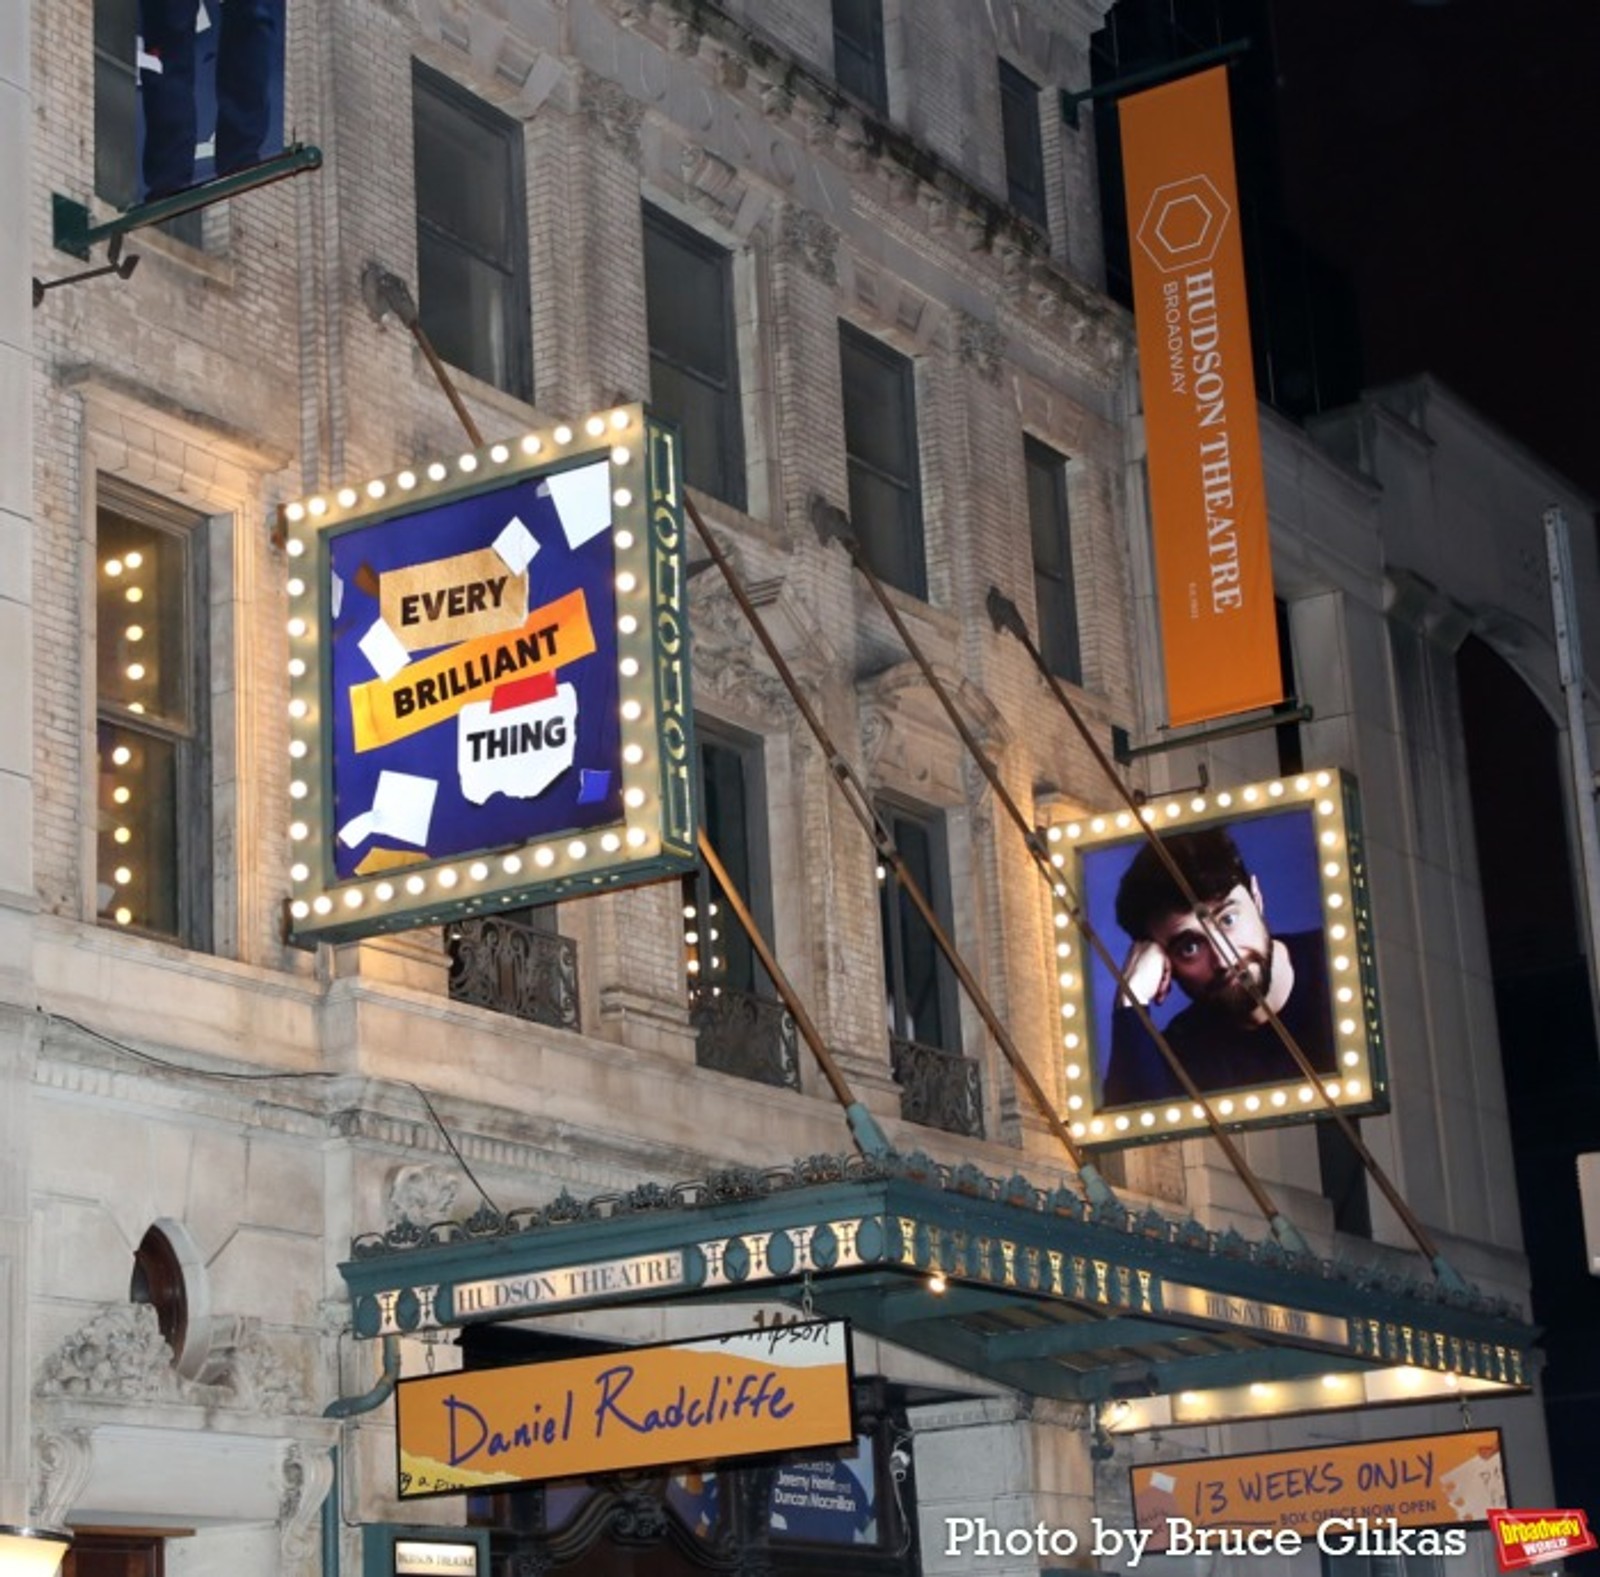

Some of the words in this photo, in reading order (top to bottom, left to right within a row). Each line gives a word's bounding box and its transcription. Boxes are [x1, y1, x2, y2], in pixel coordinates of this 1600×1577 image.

[1163, 281, 1186, 395] BROADWAY
[1185, 267, 1227, 427] HUDSON
[1200, 432, 1243, 614] THEATRE
[401, 575, 509, 626] EVERY
[393, 623, 559, 719] BRILLIANT
[466, 715, 567, 762] THING
[457, 1276, 558, 1313] HUDSON
[565, 1256, 682, 1296] THEATRE
[442, 1390, 573, 1467] Daniel
[594, 1365, 796, 1438] Radcliffe
[1195, 1480, 1229, 1517] 13
[1240, 1462, 1343, 1502] WEEKS
[1357, 1450, 1434, 1490] ONLY
[1280, 1512, 1307, 1526] BOX
[1312, 1505, 1357, 1522] OFFICE
[1361, 1503, 1395, 1518] NOW
[1399, 1499, 1438, 1515] OPEN
